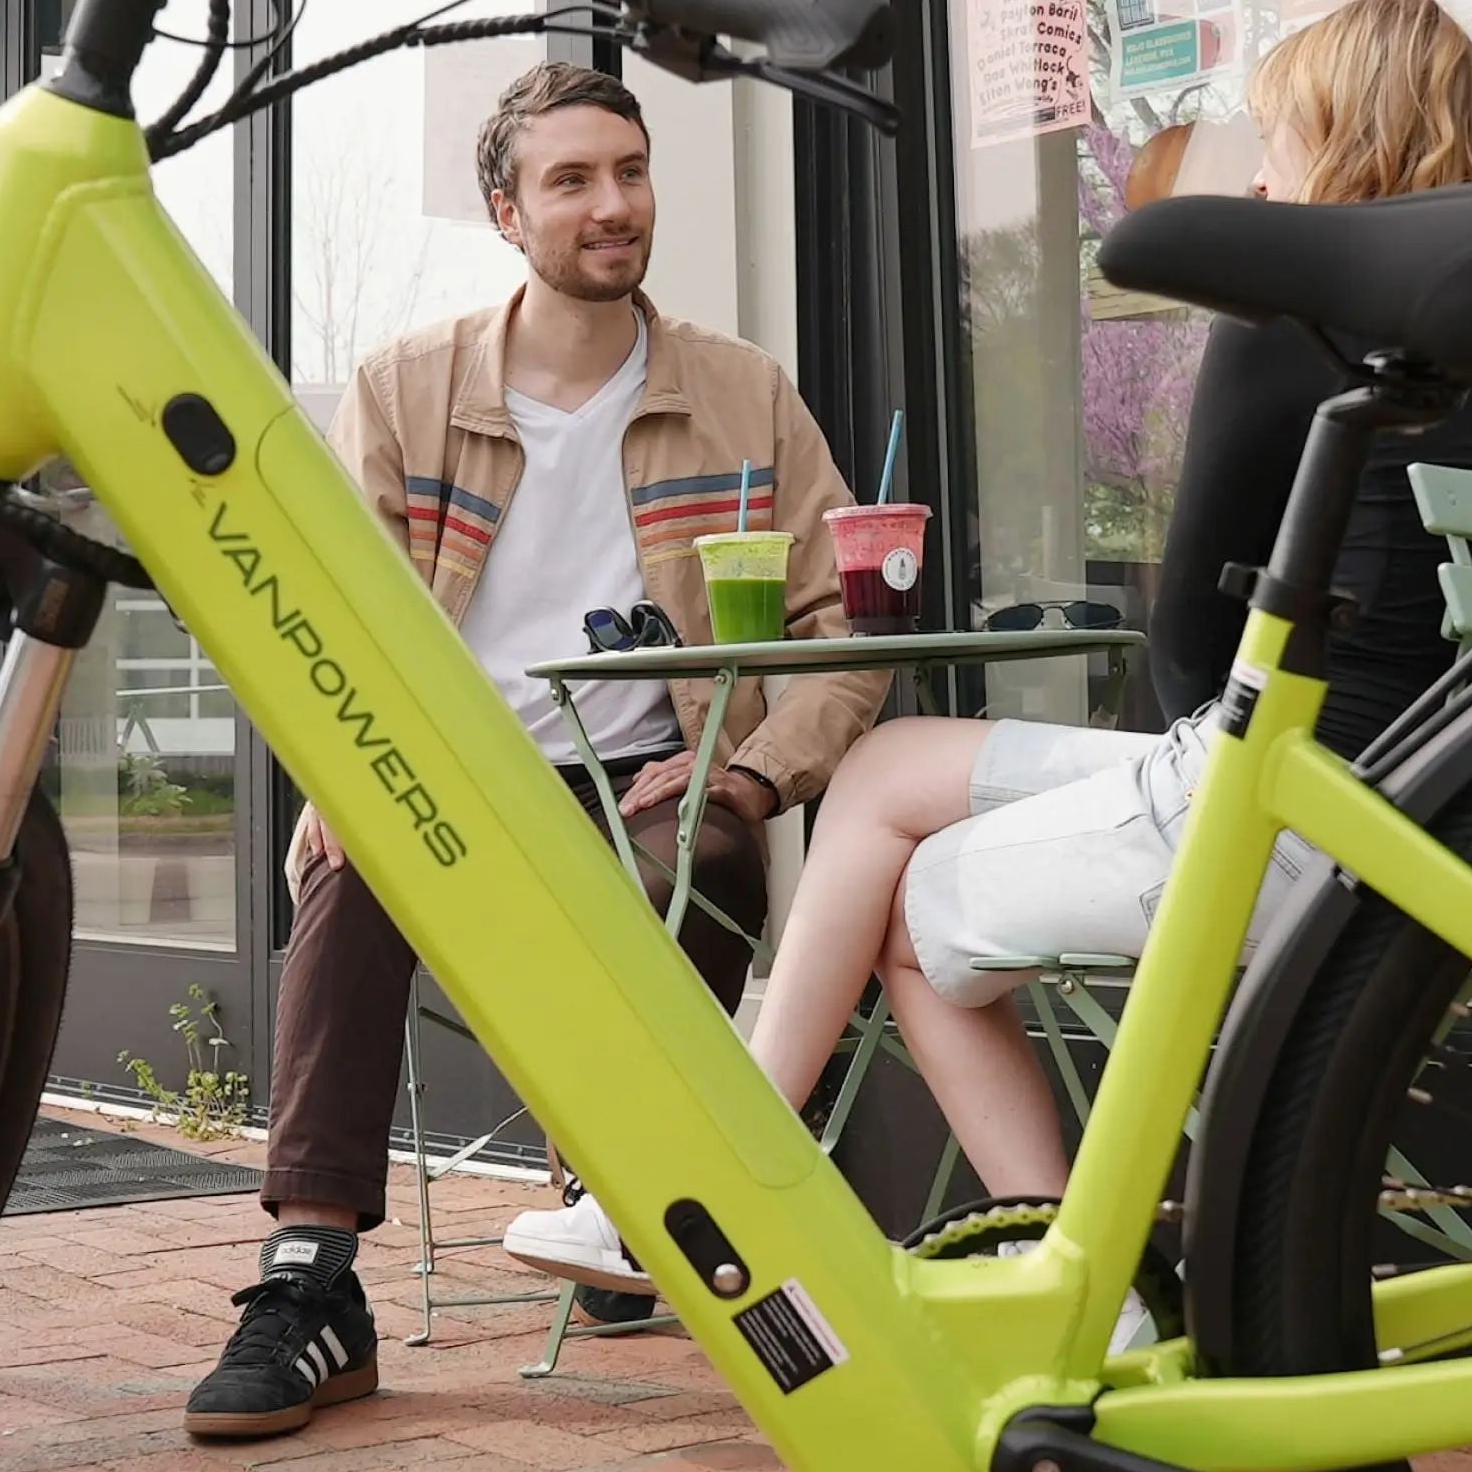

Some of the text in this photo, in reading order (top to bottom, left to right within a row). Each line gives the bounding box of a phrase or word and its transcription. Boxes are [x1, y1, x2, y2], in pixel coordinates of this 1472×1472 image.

[1048, 3, 1078, 22] Baril
[1036, 21, 1082, 46] Comics
[1009, 56, 1065, 76] Whitlock
[1014, 75, 1058, 93] Wong's
[1056, 99, 1086, 117] FREE!
[207, 501, 469, 869] VANPOWERS
